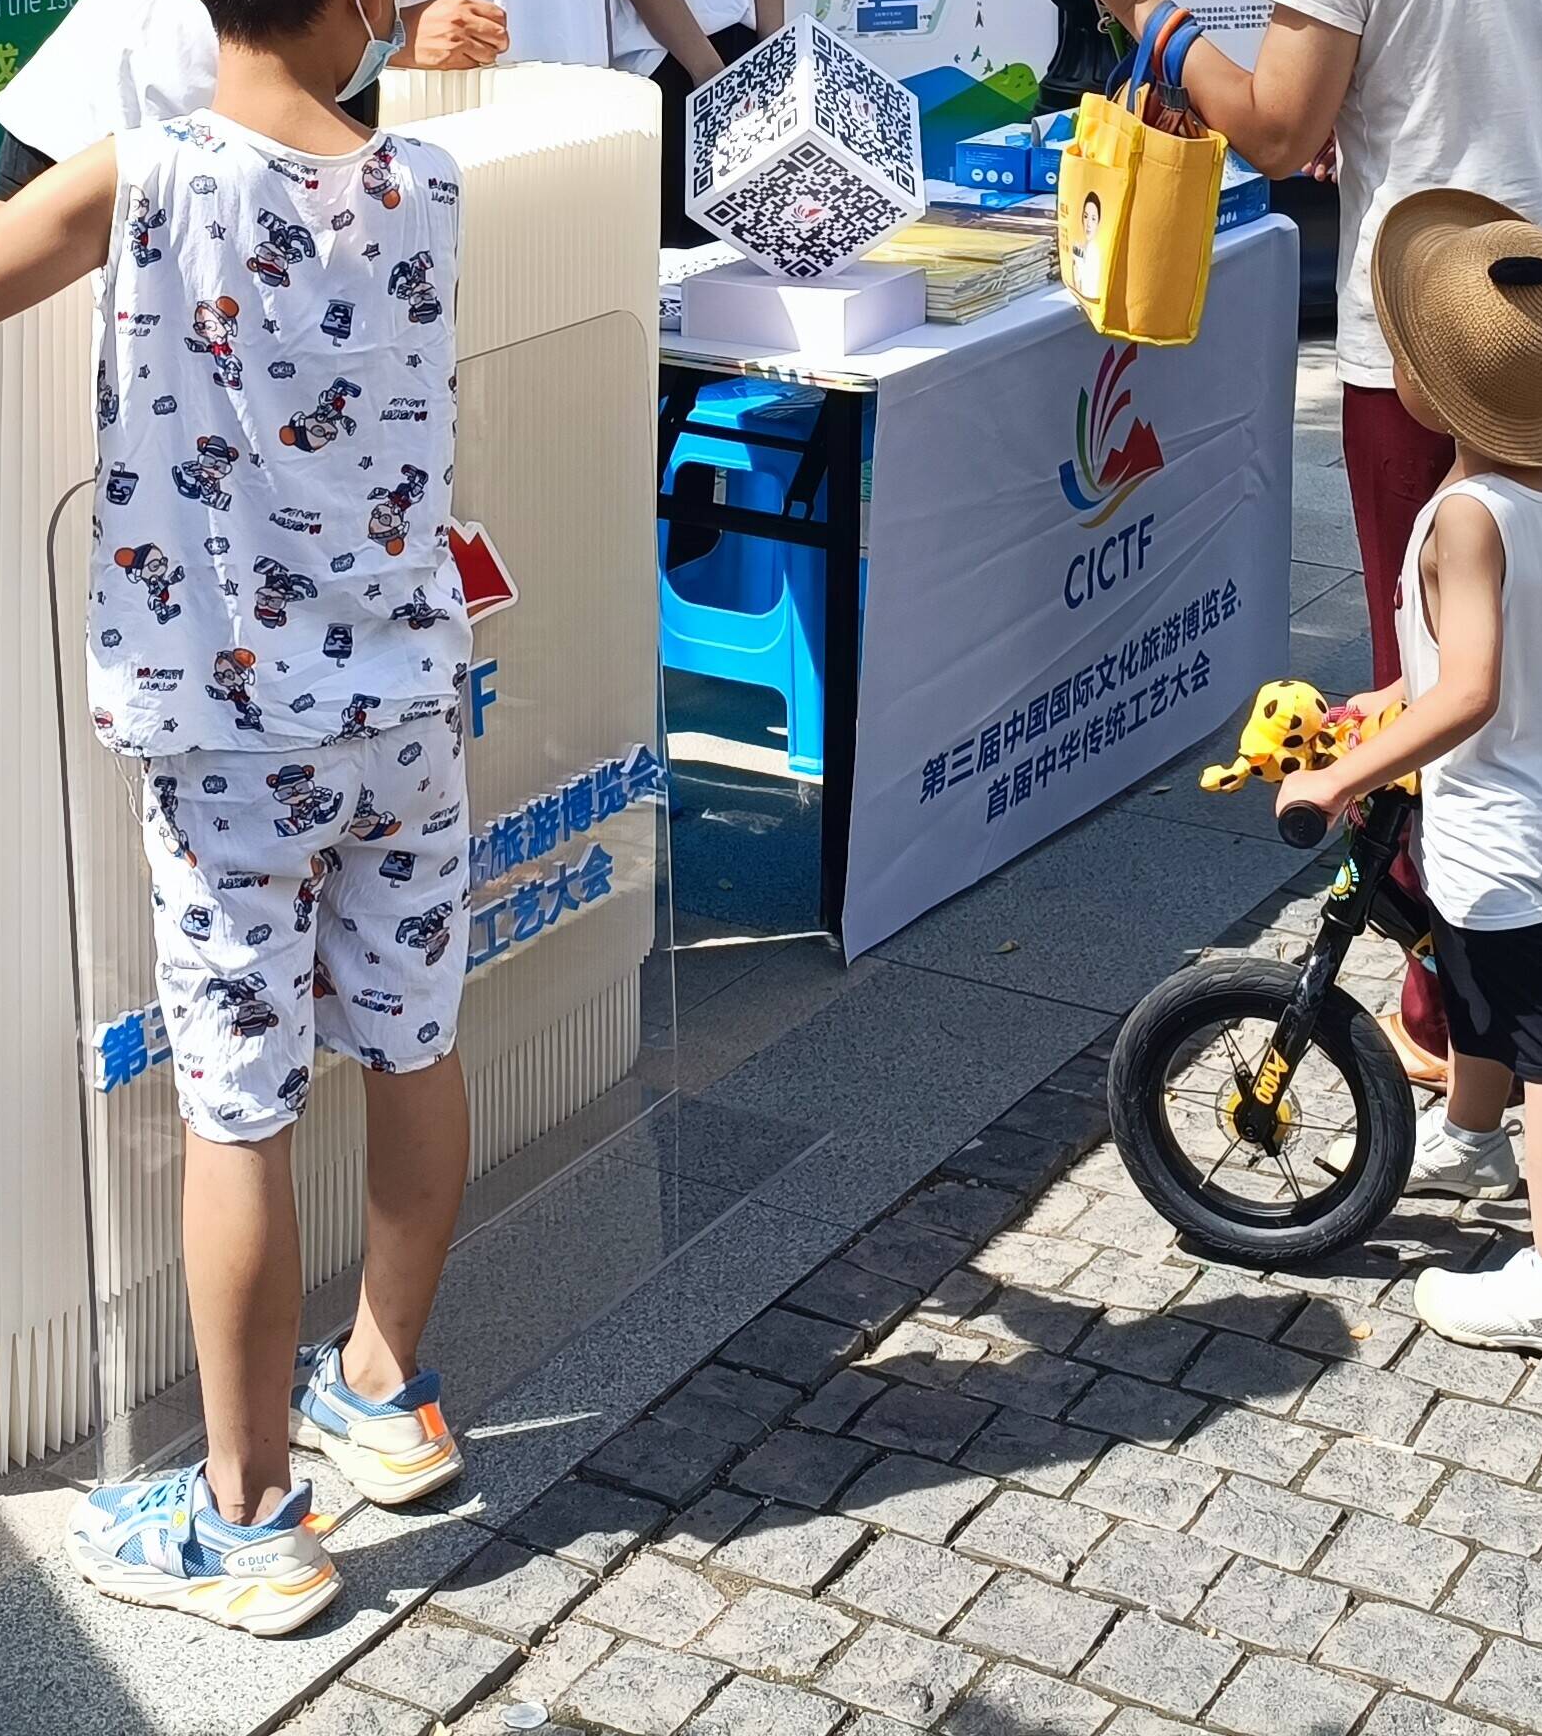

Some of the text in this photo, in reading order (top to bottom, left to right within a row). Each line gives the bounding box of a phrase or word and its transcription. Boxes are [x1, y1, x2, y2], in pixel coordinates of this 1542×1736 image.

[1063, 513, 1155, 610] CICTF
[985, 649, 1211, 824] 首届中华传统工艺大会
[465, 843, 613, 975] 工艺大会
